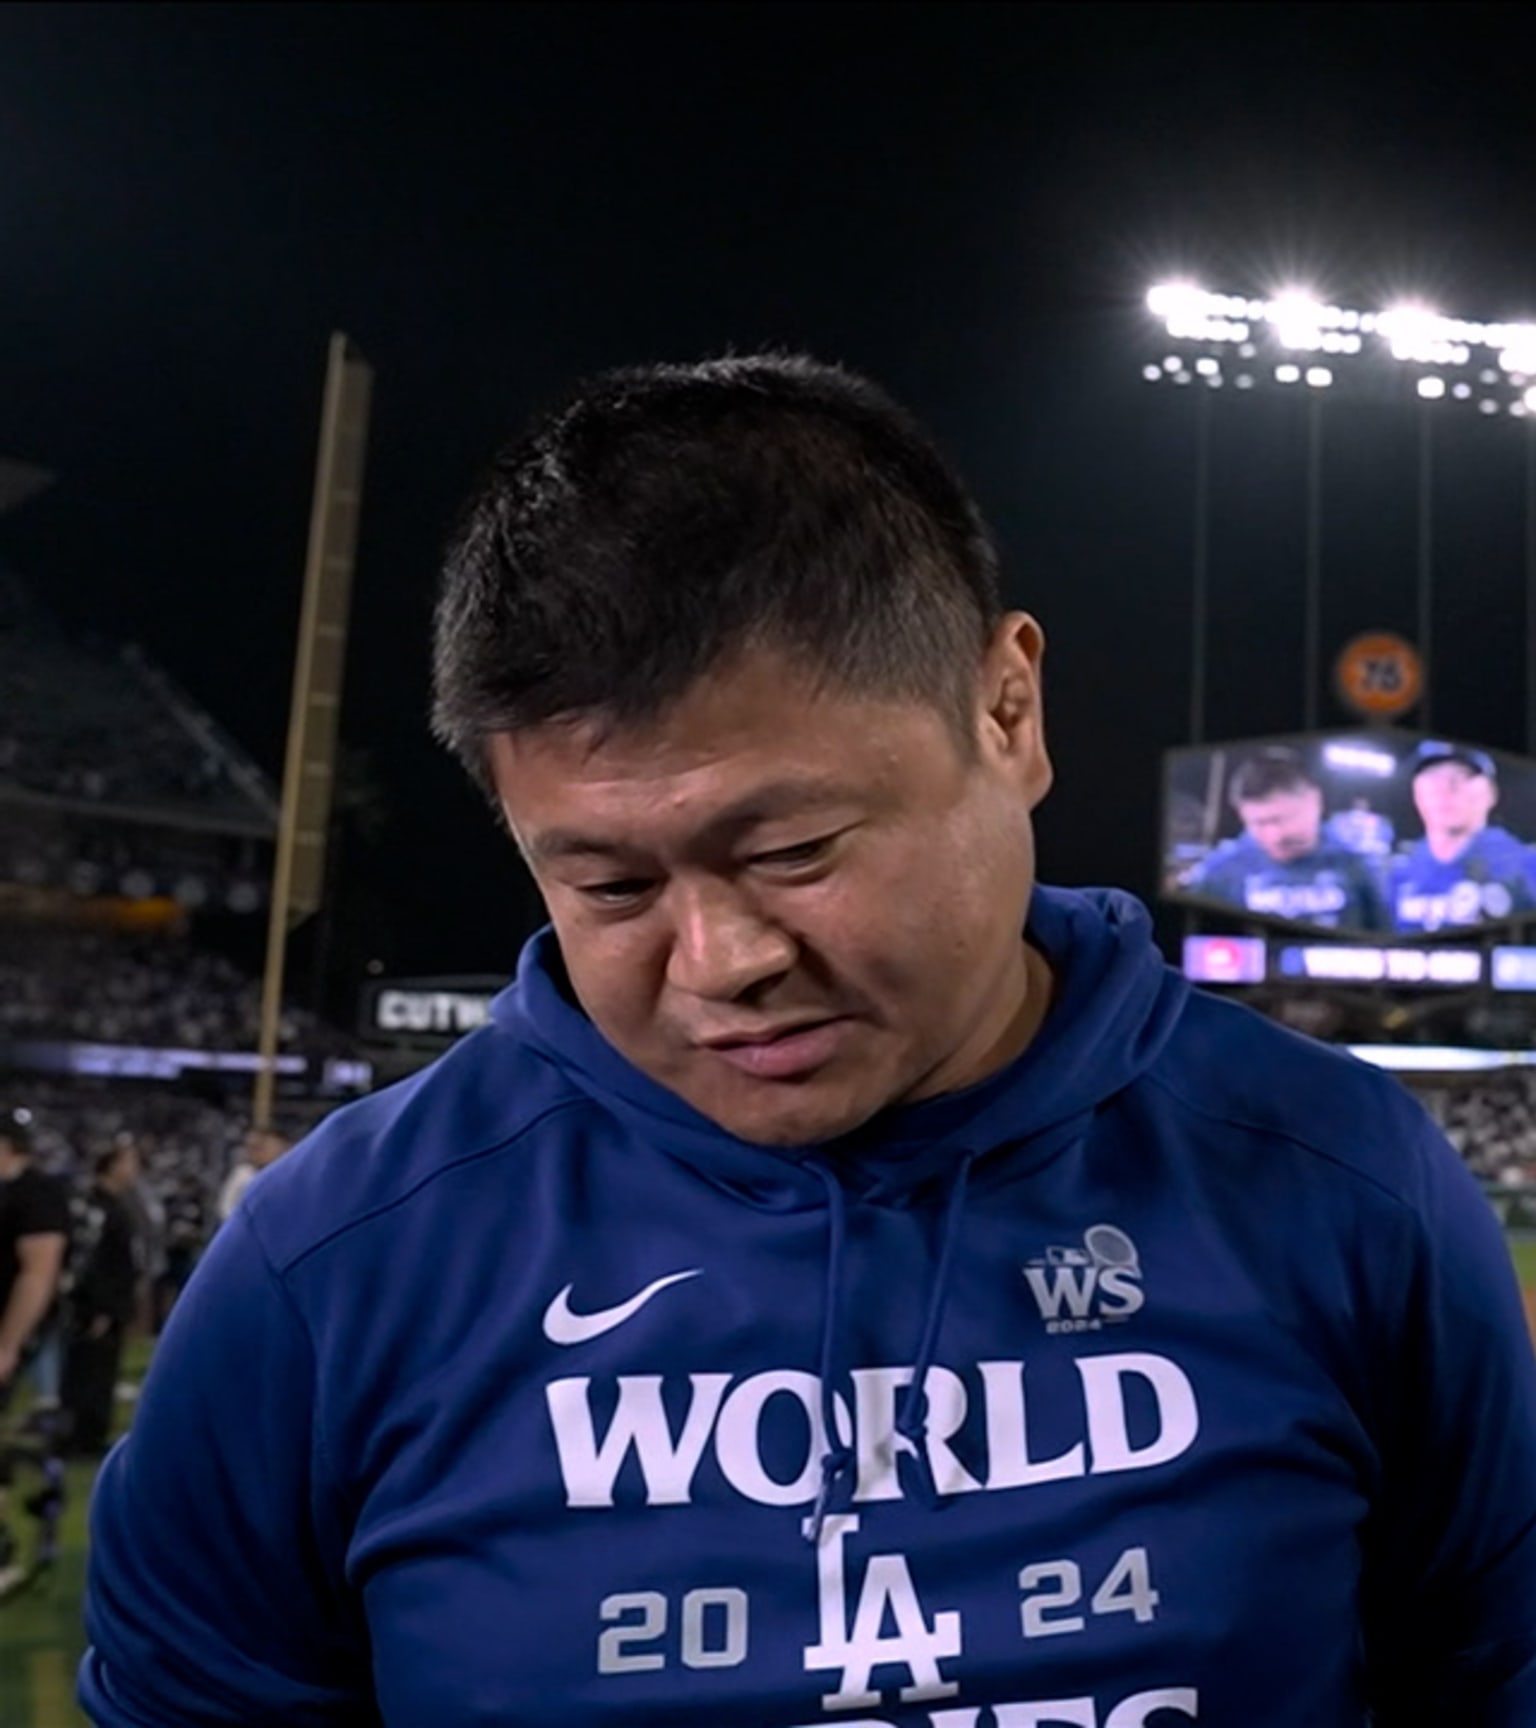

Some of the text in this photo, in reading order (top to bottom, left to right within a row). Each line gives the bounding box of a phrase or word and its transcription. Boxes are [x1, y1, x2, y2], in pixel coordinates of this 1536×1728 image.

[377, 989, 494, 1030] CUTW
[1022, 1264, 1145, 1319] WS
[1046, 1318, 1102, 1335] 2024
[545, 1352, 1200, 1508] WORLD
[598, 1587, 748, 1675] 20
[803, 1513, 962, 1711] LA
[1019, 1547, 1160, 1639] 24
